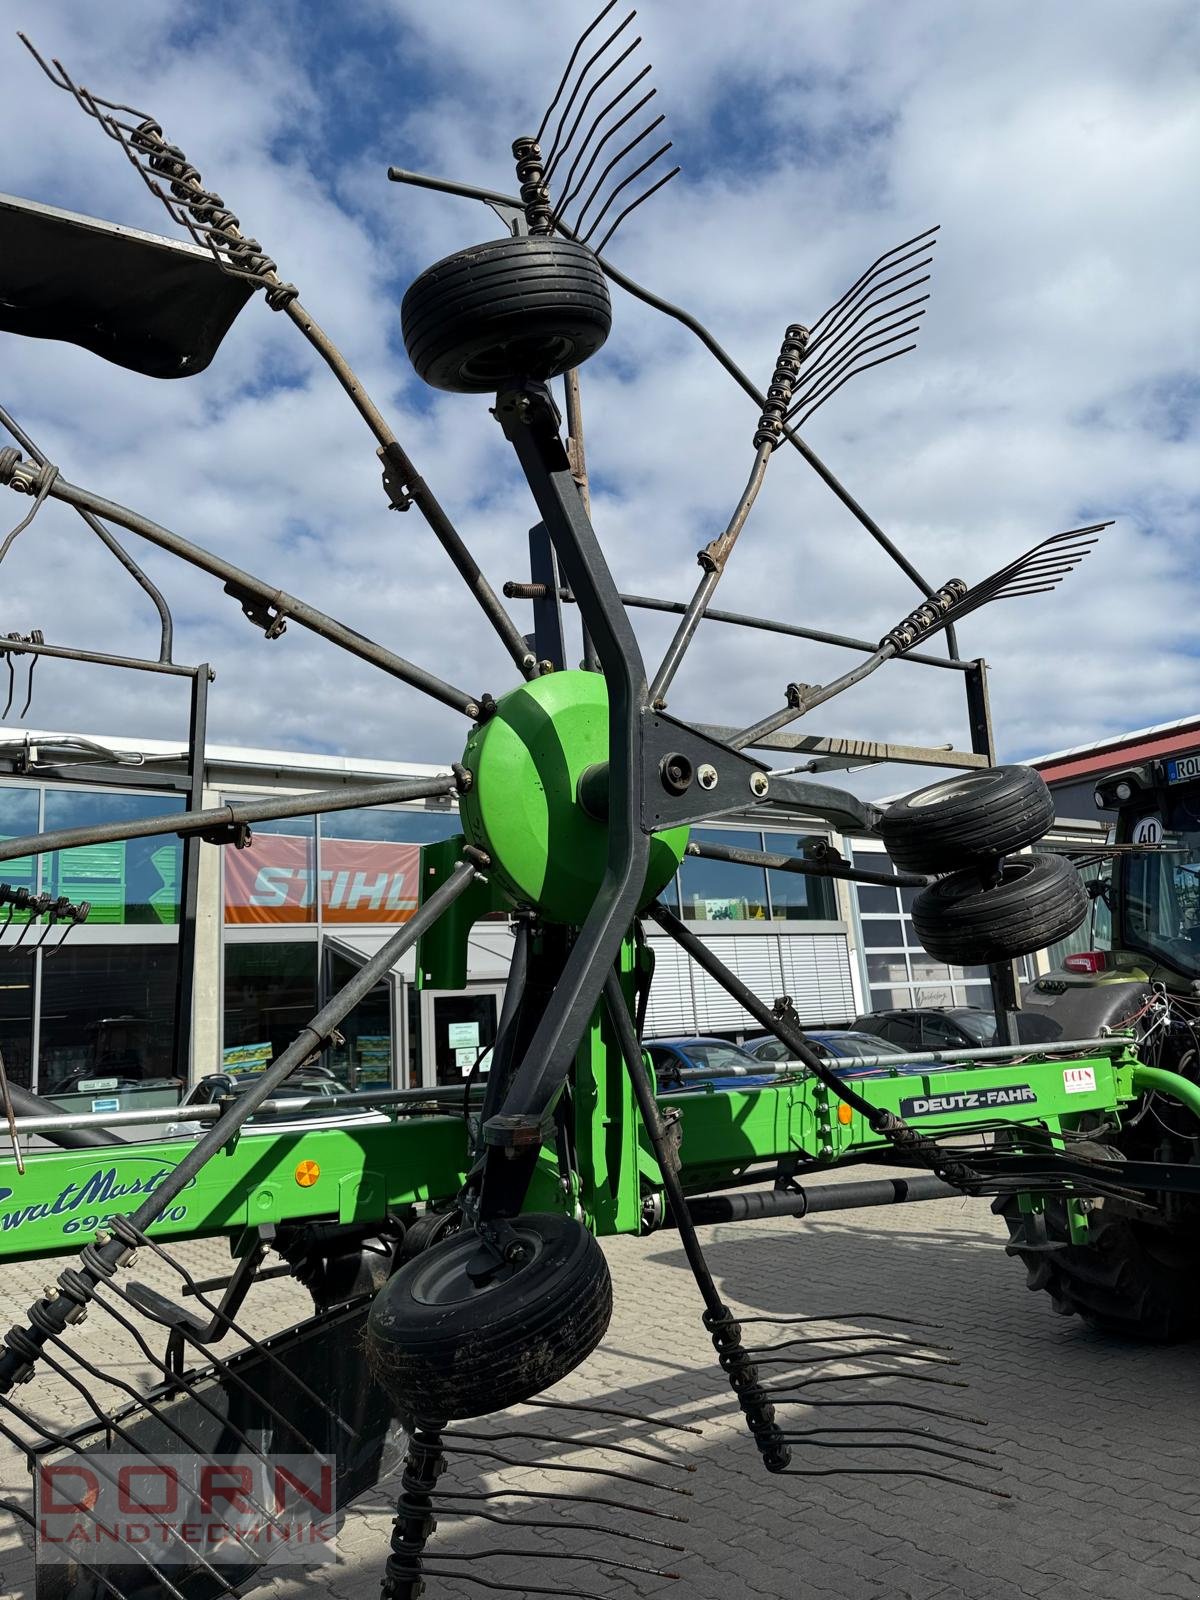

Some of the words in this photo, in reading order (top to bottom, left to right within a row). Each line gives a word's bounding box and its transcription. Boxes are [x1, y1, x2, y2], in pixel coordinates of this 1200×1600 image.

[1139, 823, 1157, 843] 40
[250, 867, 418, 910] STIHL
[913, 1087, 1035, 1114] DEUTZ-FAHR
